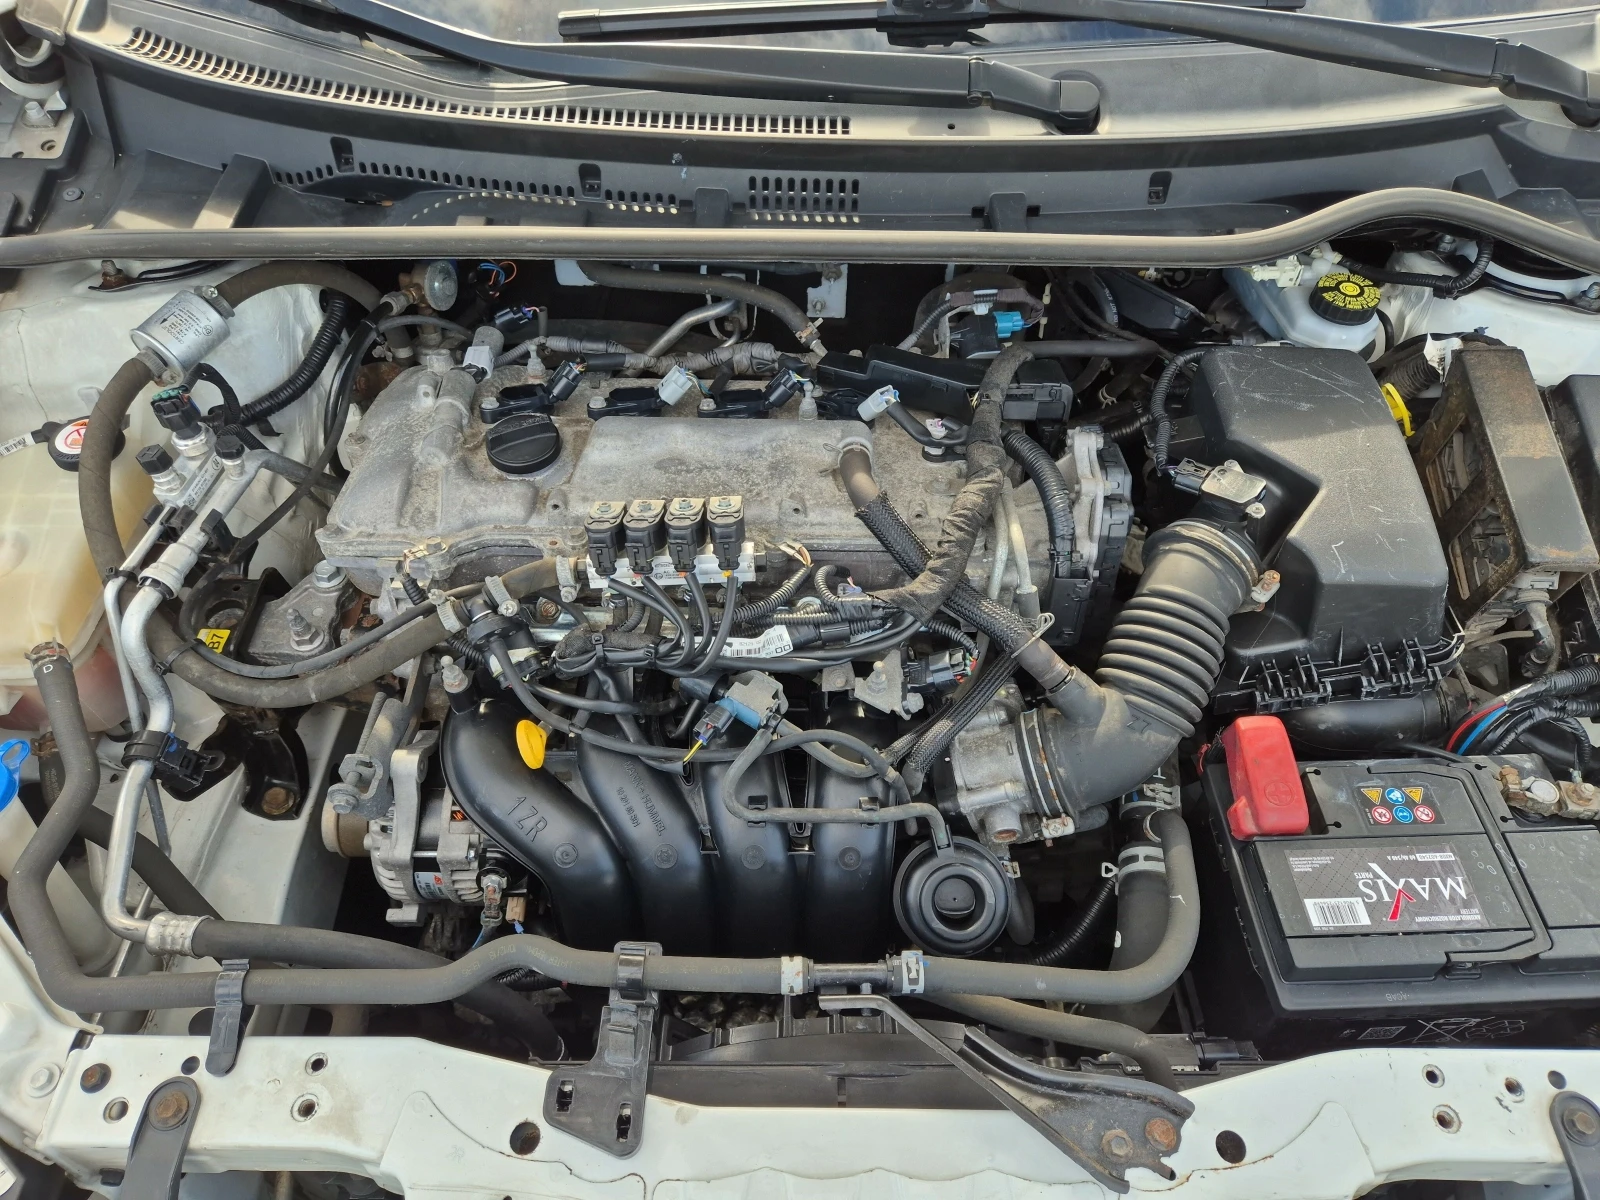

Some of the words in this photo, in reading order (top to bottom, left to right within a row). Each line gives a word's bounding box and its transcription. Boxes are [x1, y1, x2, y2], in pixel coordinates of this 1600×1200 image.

[43, 664, 53, 674] D
[507, 795, 549, 843] 1ZR
[1358, 863, 1468, 921] MAXIS
